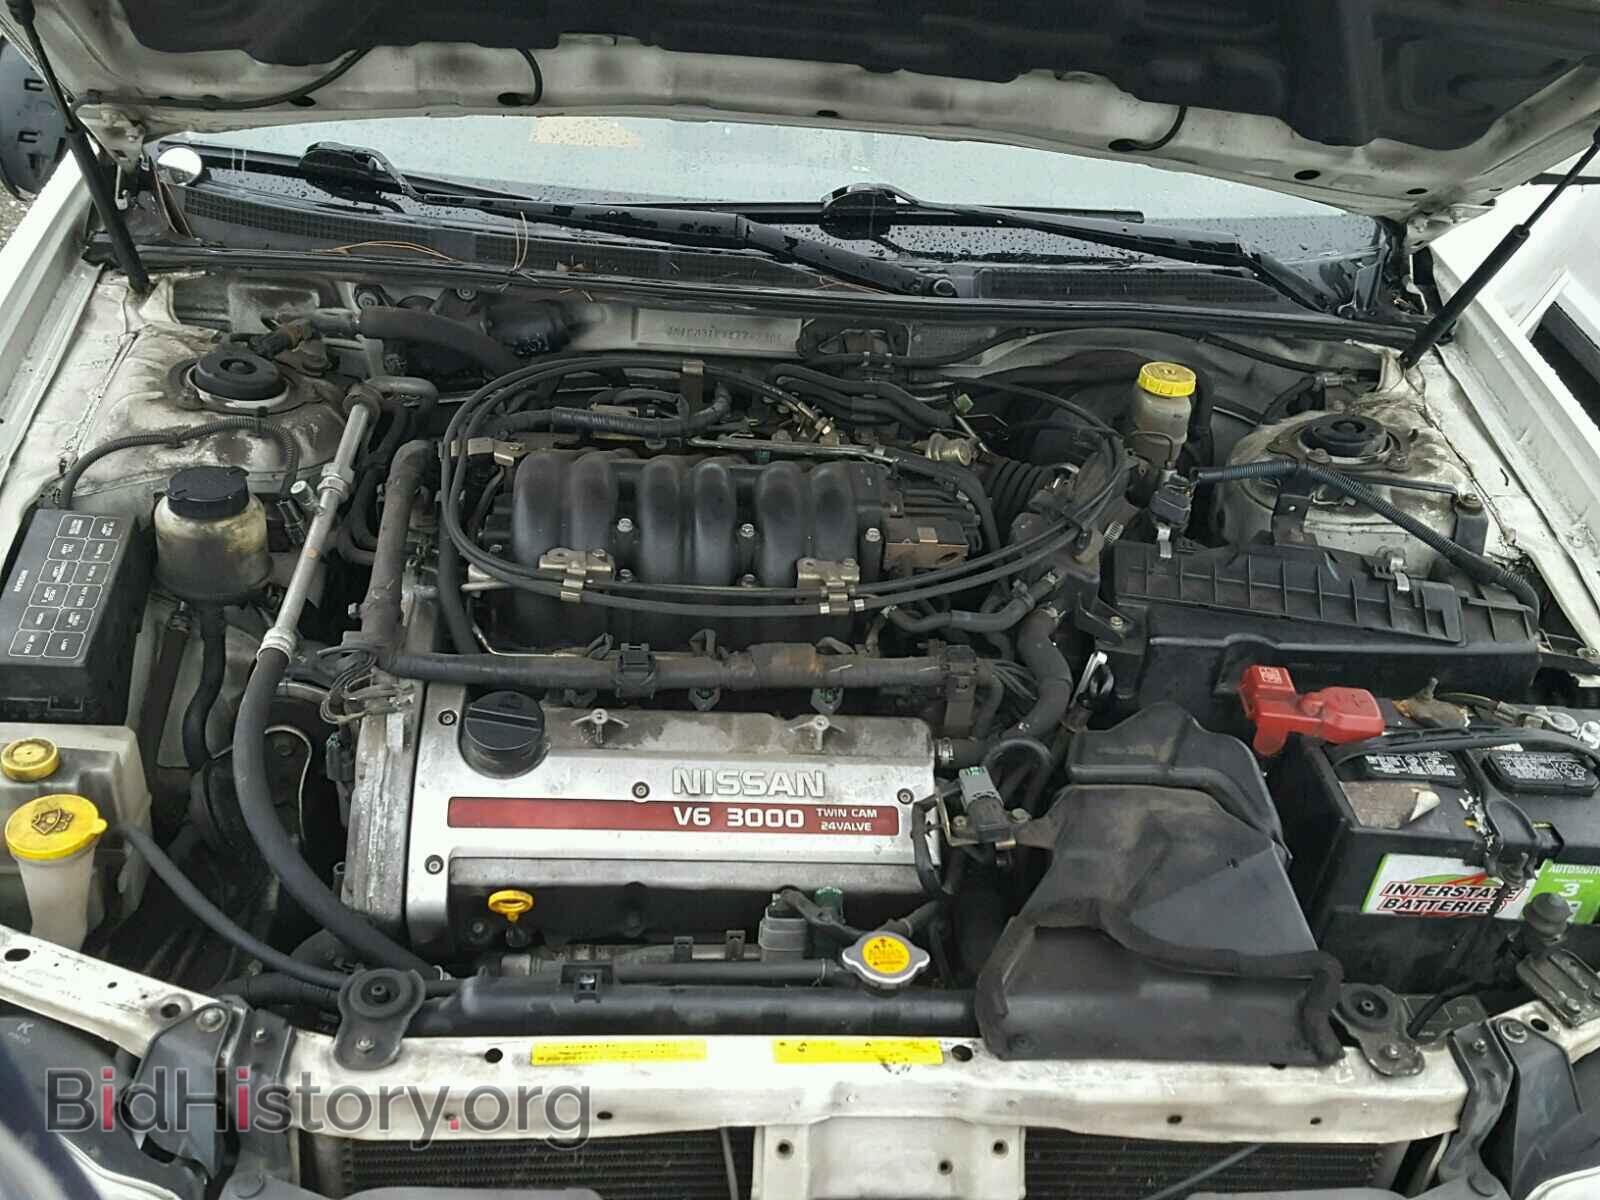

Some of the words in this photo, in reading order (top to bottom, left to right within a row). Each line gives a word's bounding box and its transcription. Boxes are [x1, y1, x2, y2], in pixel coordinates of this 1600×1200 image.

[672, 767, 825, 798] NISSAN
[673, 806, 711, 826] V6
[727, 807, 805, 828] 3000
[816, 807, 847, 818] TWIN
[851, 808, 878, 818] CAM
[821, 821, 873, 832] 24VALVE
[1558, 883, 1581, 897] 3
[1383, 898, 1502, 914] BATTERIE
